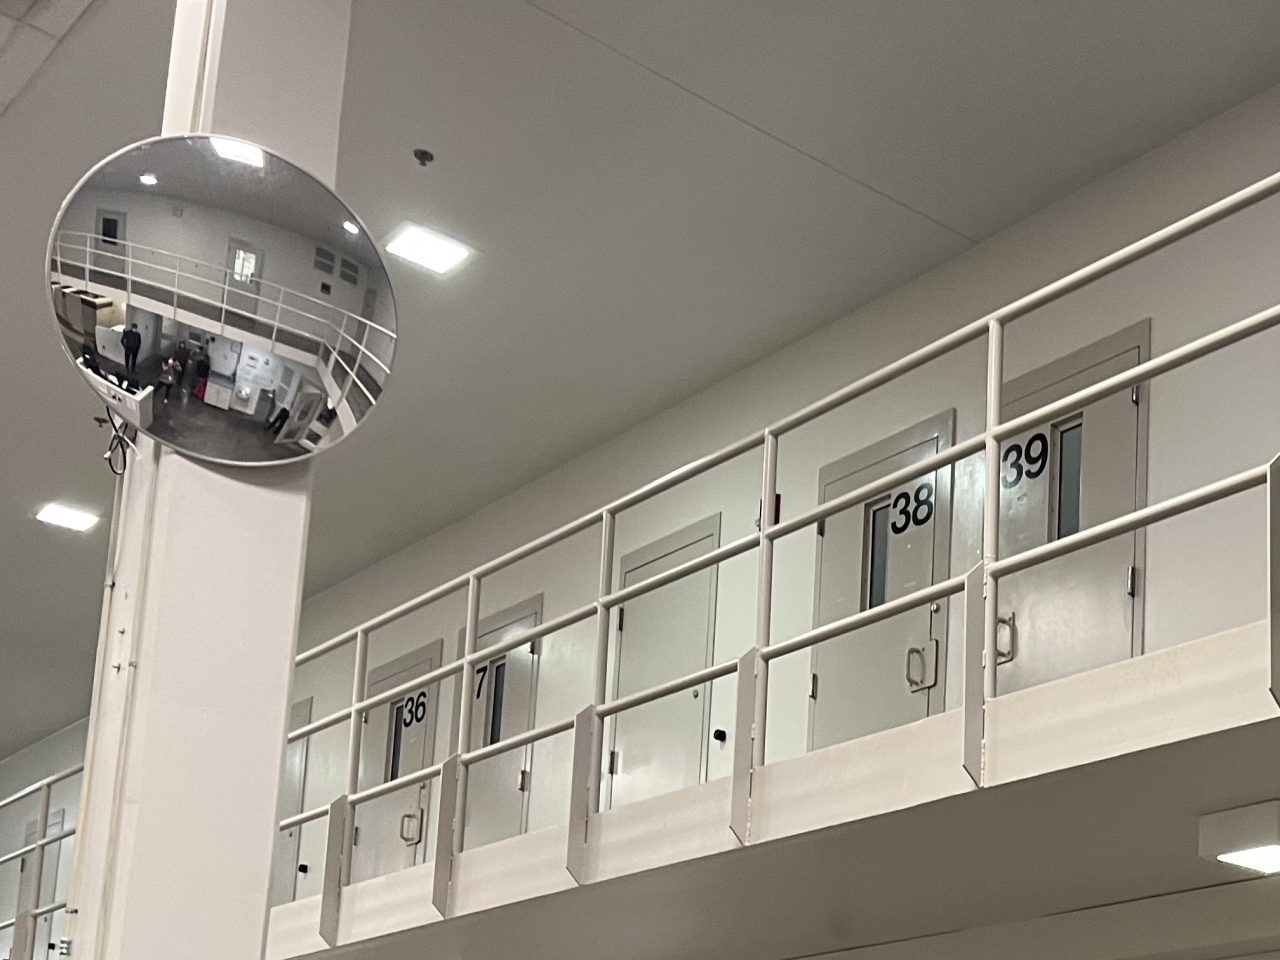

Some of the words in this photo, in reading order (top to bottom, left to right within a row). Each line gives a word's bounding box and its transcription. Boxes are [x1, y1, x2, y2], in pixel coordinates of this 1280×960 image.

[1001, 433, 1048, 489] 39
[891, 483, 934, 534] 38
[476, 665, 488, 699] 7
[403, 691, 427, 728] 36
